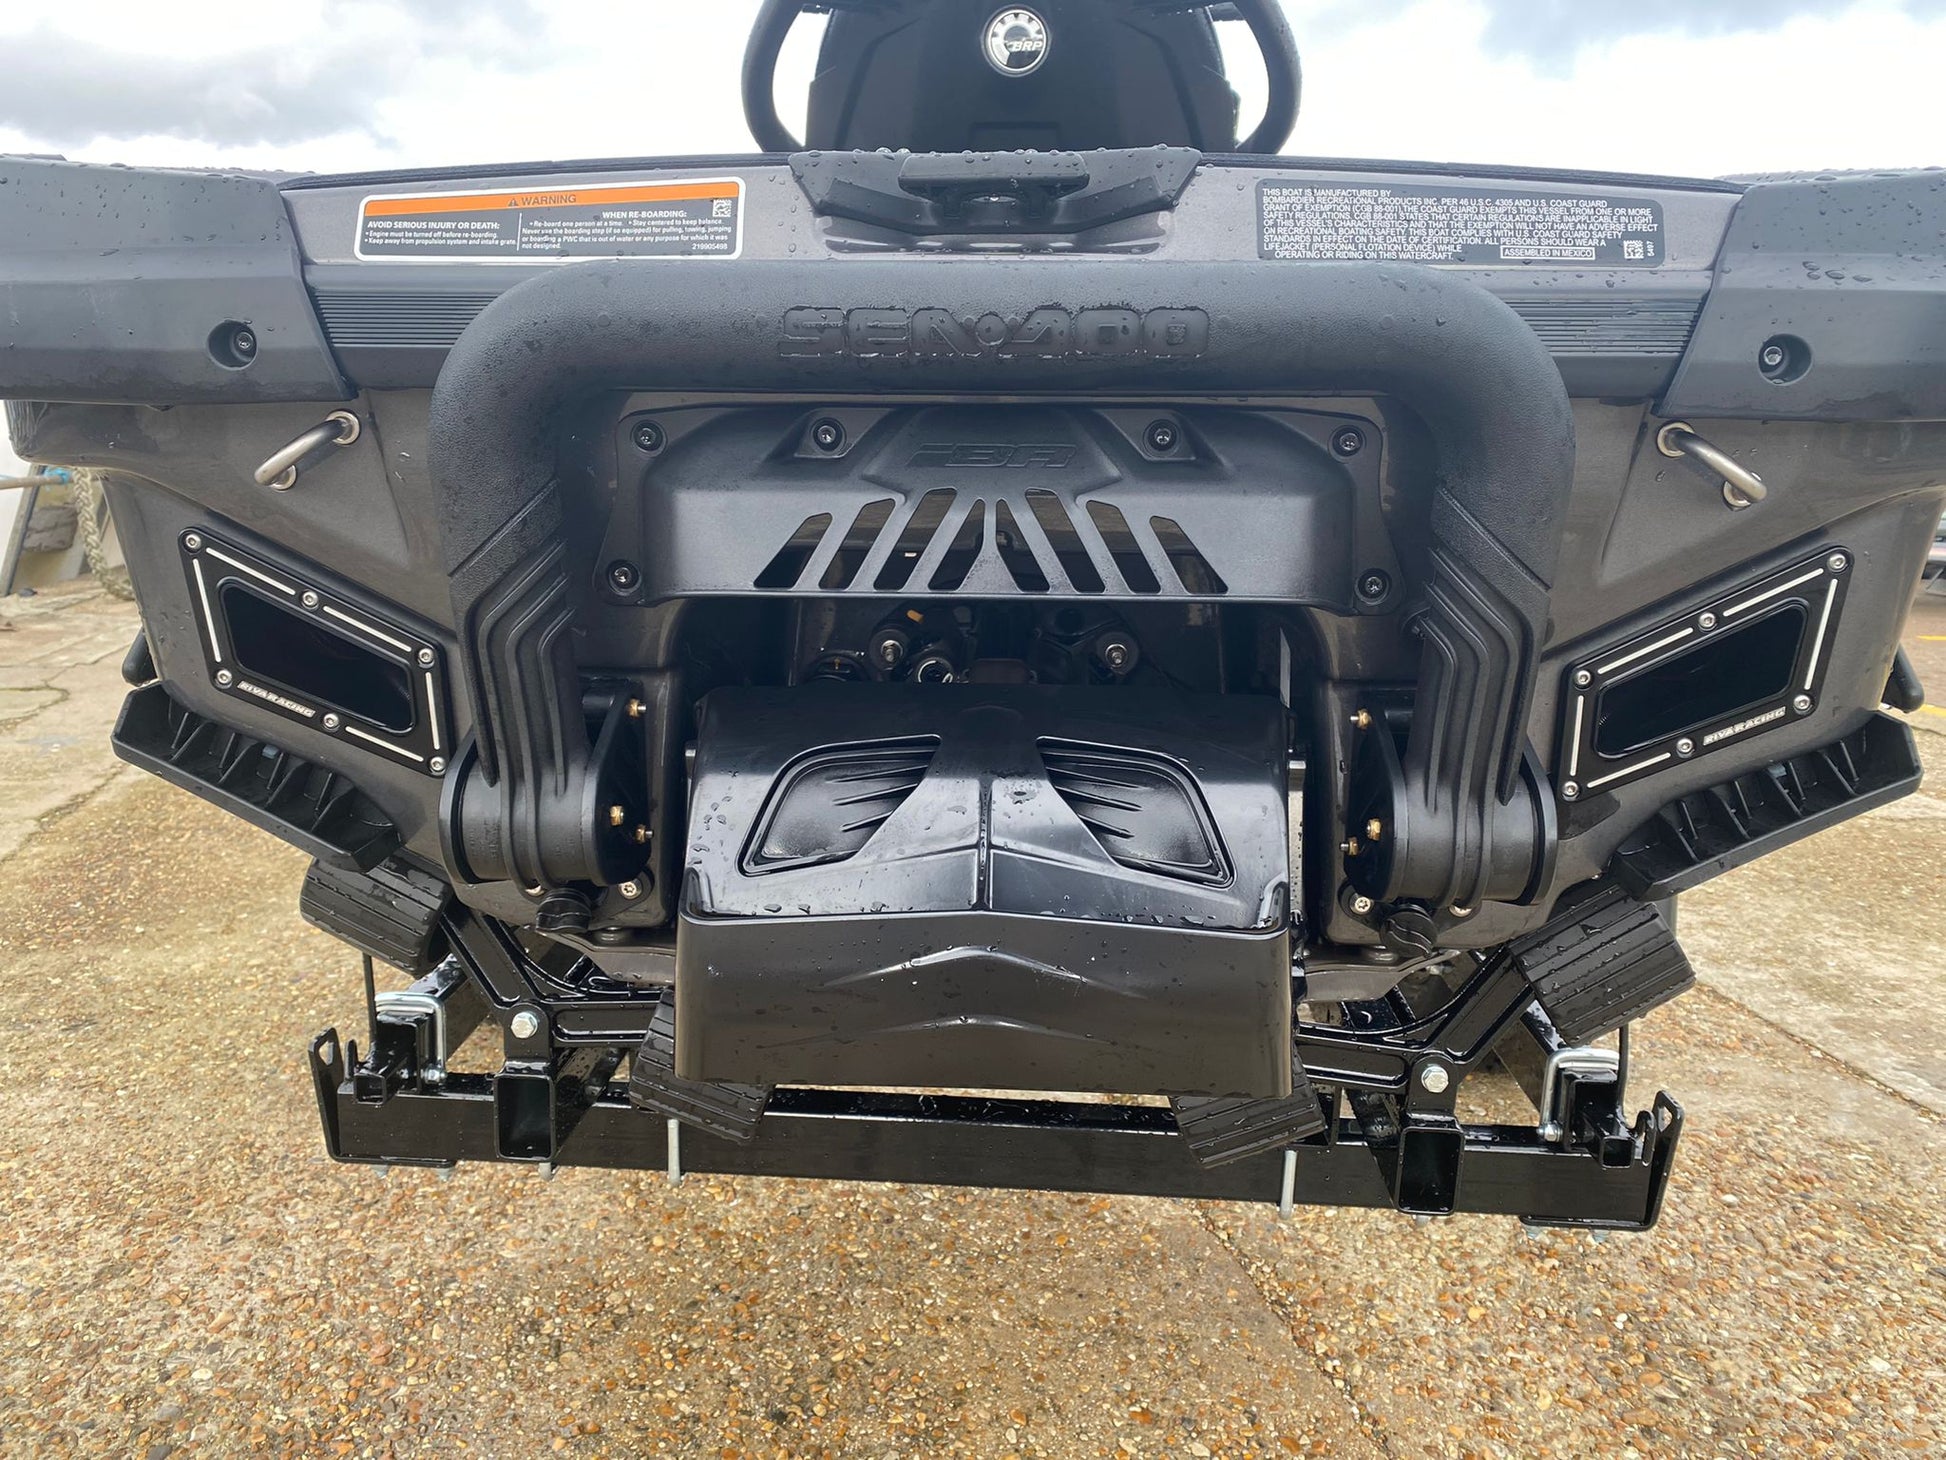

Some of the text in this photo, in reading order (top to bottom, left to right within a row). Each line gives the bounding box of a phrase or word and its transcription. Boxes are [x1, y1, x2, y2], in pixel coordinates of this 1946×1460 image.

[1013, 41, 1043, 51] BRP
[1262, 188, 1391, 197] THIS BOAT IS MANUFACTURED BY
[521, 194, 576, 206] WARNING
[1263, 196, 1315, 204] BOMBARDIER
[1316, 196, 1376, 204] RECREATIONAL
[1378, 197, 1422, 205] PRODUCTS
[1441, 197, 1458, 205] PER
[1495, 198, 1513, 206] 4305
[1549, 199, 1577, 207] COAST
[1578, 200, 1608, 208] GUARD
[628, 210, 687, 218] RE-BOARDING:
[1263, 203, 1290, 211] GRANT
[1304, 204, 1351, 212] EXEMPTION
[1403, 205, 1419, 213] THE
[1420, 205, 1447, 213] COAST
[1449, 205, 1478, 213] GUARD
[1480, 206, 1517, 214] EXEMPTS
[1518, 206, 1537, 214] THIS
[1538, 207, 1569, 215] VESSEL
[1571, 207, 1594, 215] FROM
[1595, 207, 1613, 215] ONE
[1614, 207, 1627, 215] OR
[1628, 208, 1652, 216] MORE
[1354, 212, 1372, 220] CGB
[1399, 212, 1430, 220] STATES
[1431, 213, 1450, 221] THAT
[1452, 213, 1486, 221] CERTAIN
[1488, 214, 1544, 222] REGULATIONS
[1545, 214, 1561, 222] ARE
[1563, 215, 1619, 223] INAPPLICABLE
[1620, 215, 1629, 223] IN
[393, 221, 427, 229] SERIOUS
[428, 221, 456, 229] INJURY
[1334, 220, 1408, 228] CHARACTERISTICS
[1409, 220, 1426, 228] AND
[1467, 221, 1514, 229] EXEMPTION
[1535, 222, 1552, 230] NOT
[1553, 222, 1575, 230] HAVE
[1588, 223, 1626, 231] ADVERSE
[1627, 223, 1658, 232] EFFECT
[1263, 227, 1276, 235] ON
[1277, 227, 1337, 235] RECREATIONAL
[1409, 228, 1427, 236] THIS
[1428, 228, 1450, 236] BOAT
[1450, 229, 1492, 237] COMPLIES
[1493, 229, 1514, 237] WITH
[1533, 230, 1560, 238] COAST
[1561, 230, 1590, 239] GUARD
[1591, 231, 1622, 239] SAFETY
[1263, 235, 1311, 243] STANDARDS
[1313, 235, 1321, 243] IN
[1322, 235, 1353, 243] EFFECT
[1354, 235, 1367, 243] ON
[1408, 236, 1420, 244] OF
[1484, 237, 1499, 245] ALL
[1500, 237, 1539, 246] PERSONS
[1540, 238, 1574, 246] SHOULD
[1574, 239, 1599, 247] WEAR
[1600, 239, 1606, 247] A
[1263, 243, 1462, 252] LIFEJACKET (PERSONAL FLOTATION DEVICE) WHILE
[1274, 251, 1320, 259] OPERATING
[1321, 251, 1334, 259] OR
[1335, 251, 1364, 259] RIDING
[1364, 251, 1377, 259] ON
[1378, 251, 1397, 259] THIS
[1504, 249, 1551, 257] ASSEMBLED
[1552, 249, 1560, 257] IN
